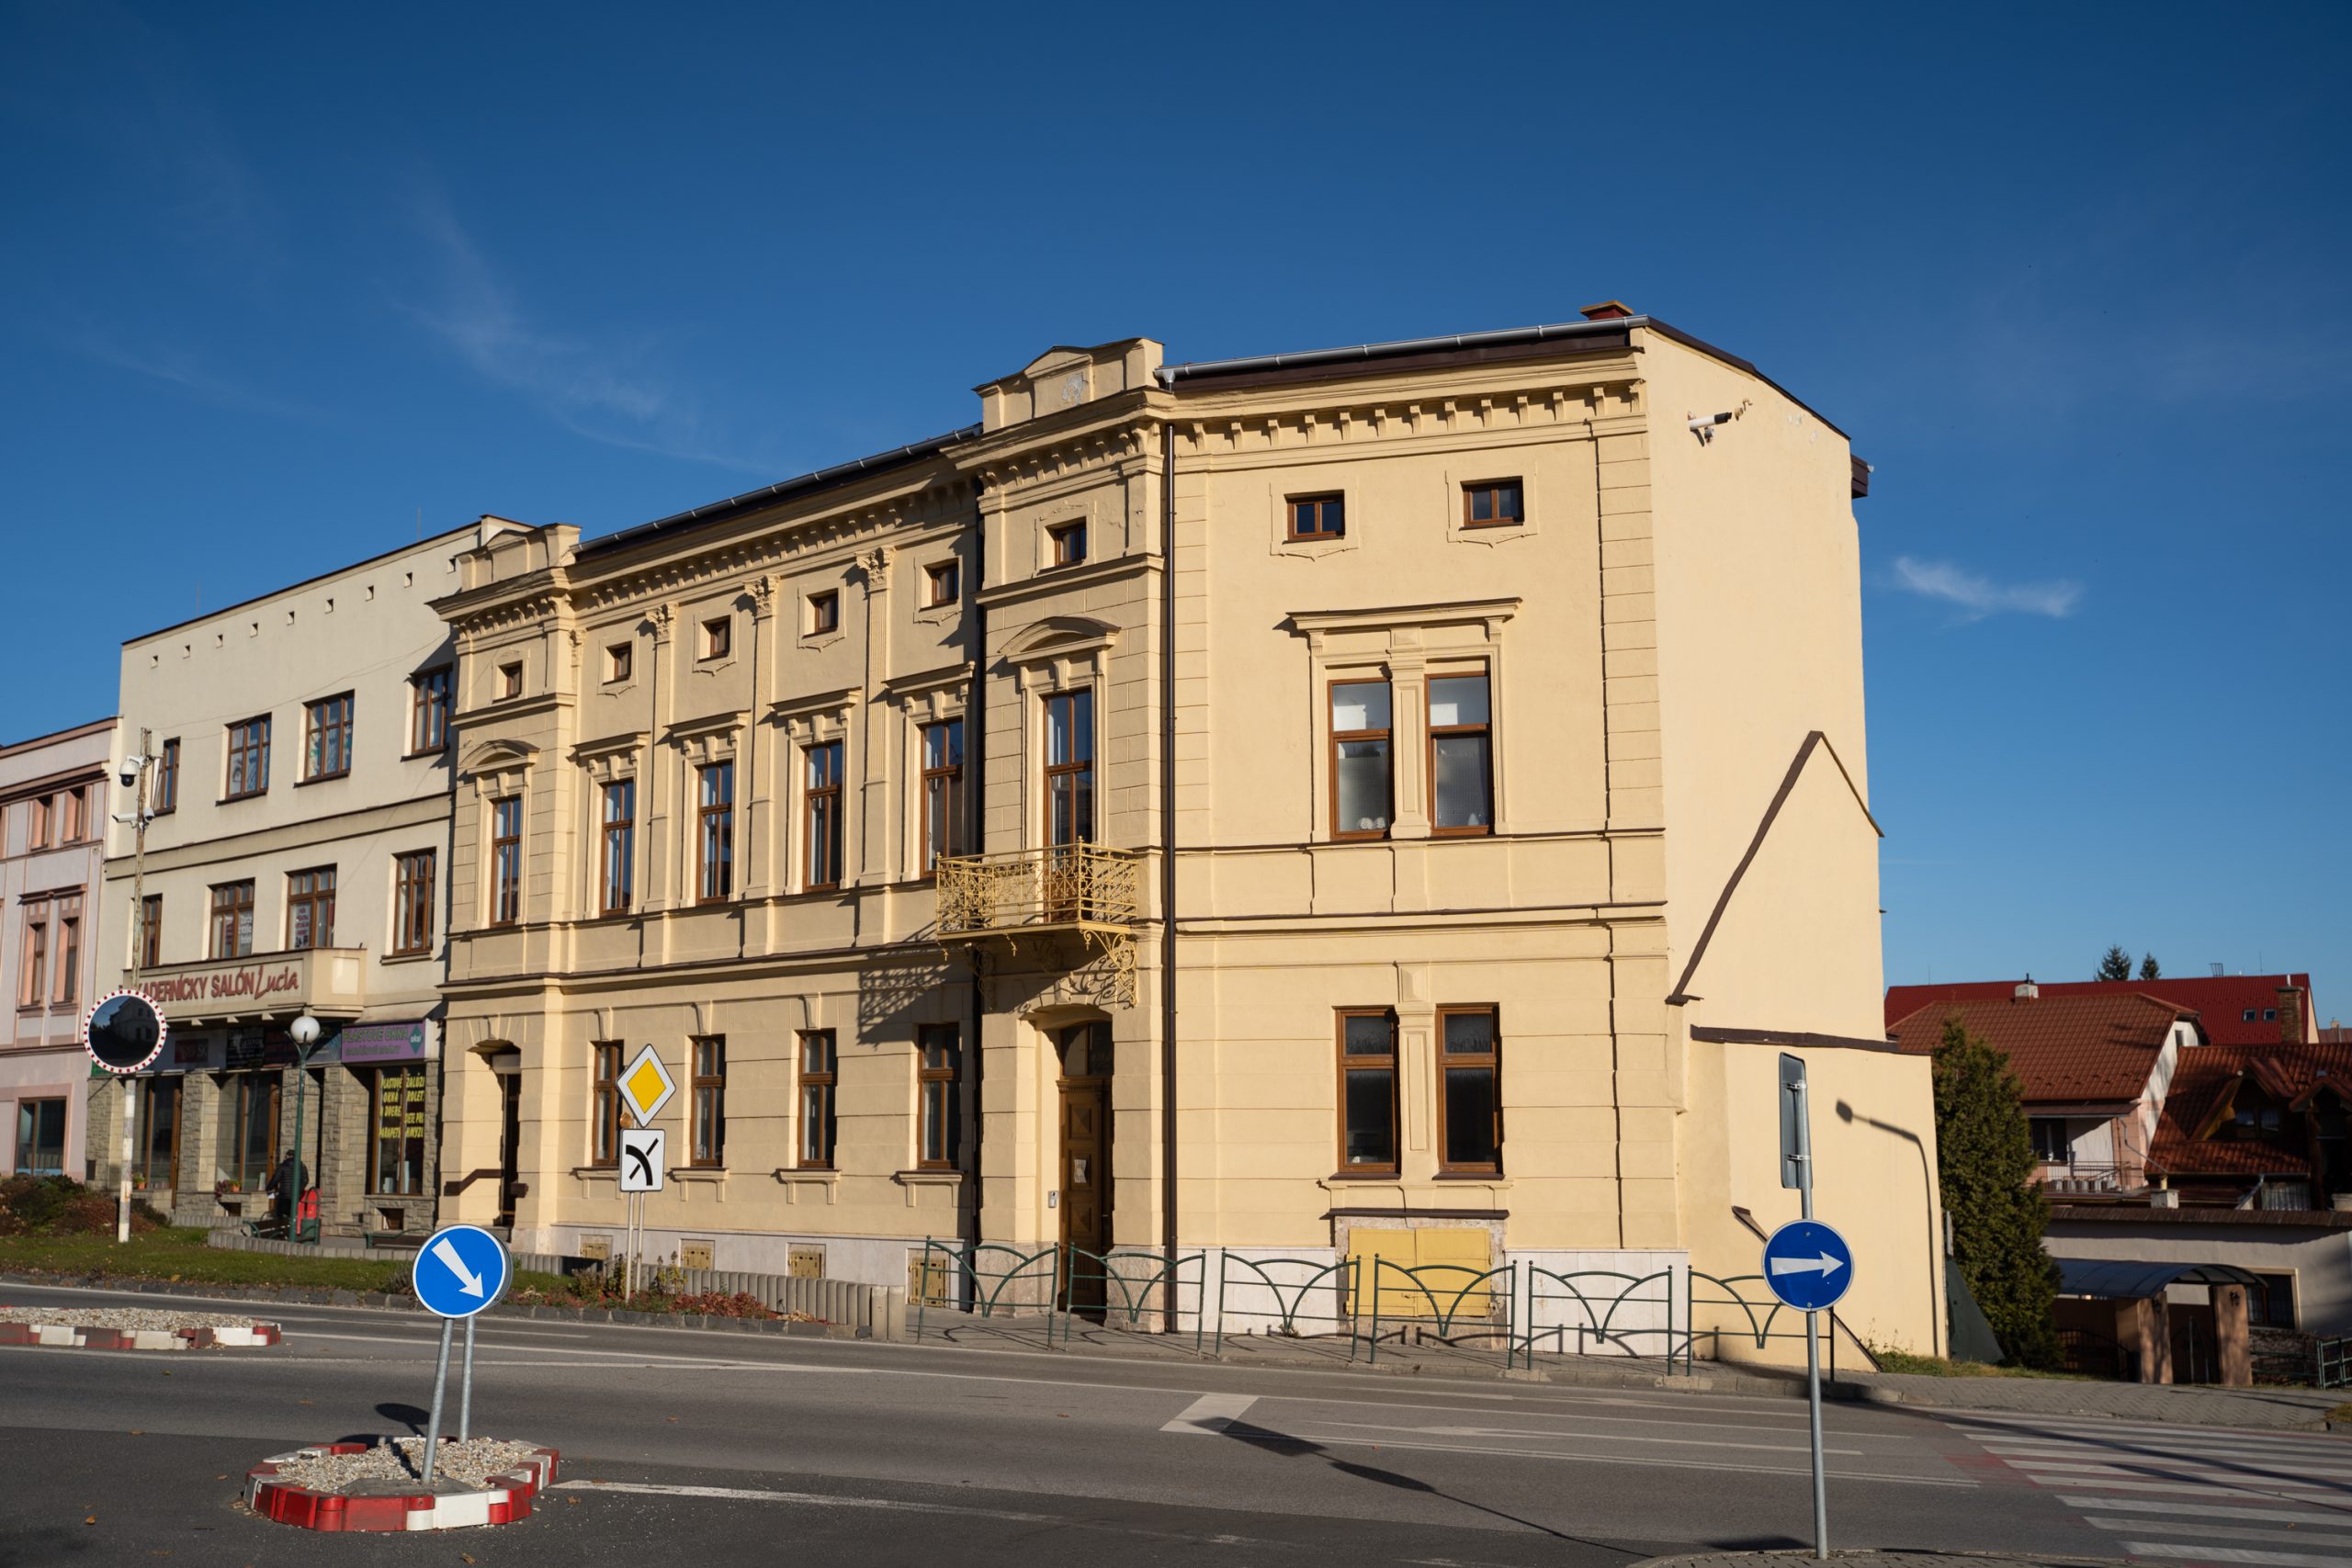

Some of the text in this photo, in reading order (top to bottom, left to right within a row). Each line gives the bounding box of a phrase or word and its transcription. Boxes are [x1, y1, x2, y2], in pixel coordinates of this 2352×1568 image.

[139, 964, 299, 1002] ADERNÍCKY SALÓN Lucia
